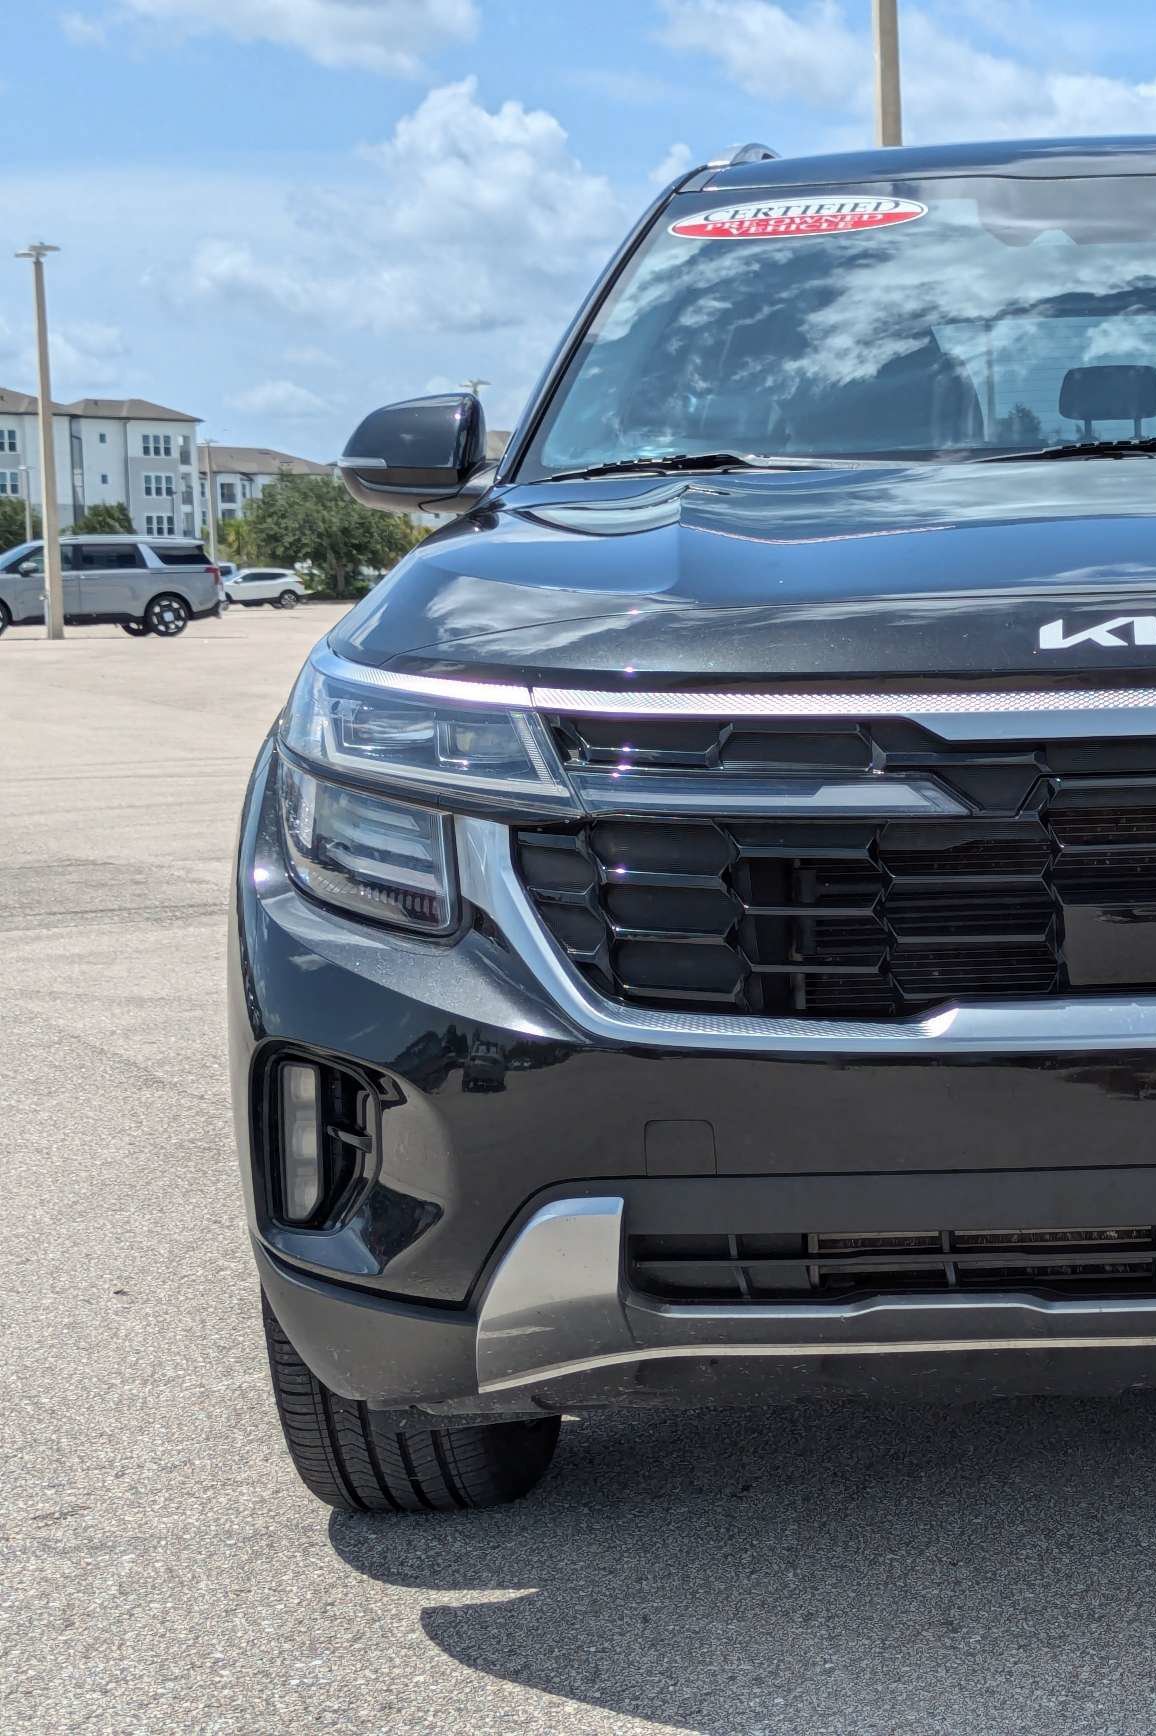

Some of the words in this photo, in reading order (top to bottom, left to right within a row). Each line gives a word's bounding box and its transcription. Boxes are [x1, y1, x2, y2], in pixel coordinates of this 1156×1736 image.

[704, 200, 900, 222] CERTIFIED
[705, 213, 885, 231] PRE-OWNED
[731, 221, 854, 235] VEHICLE
